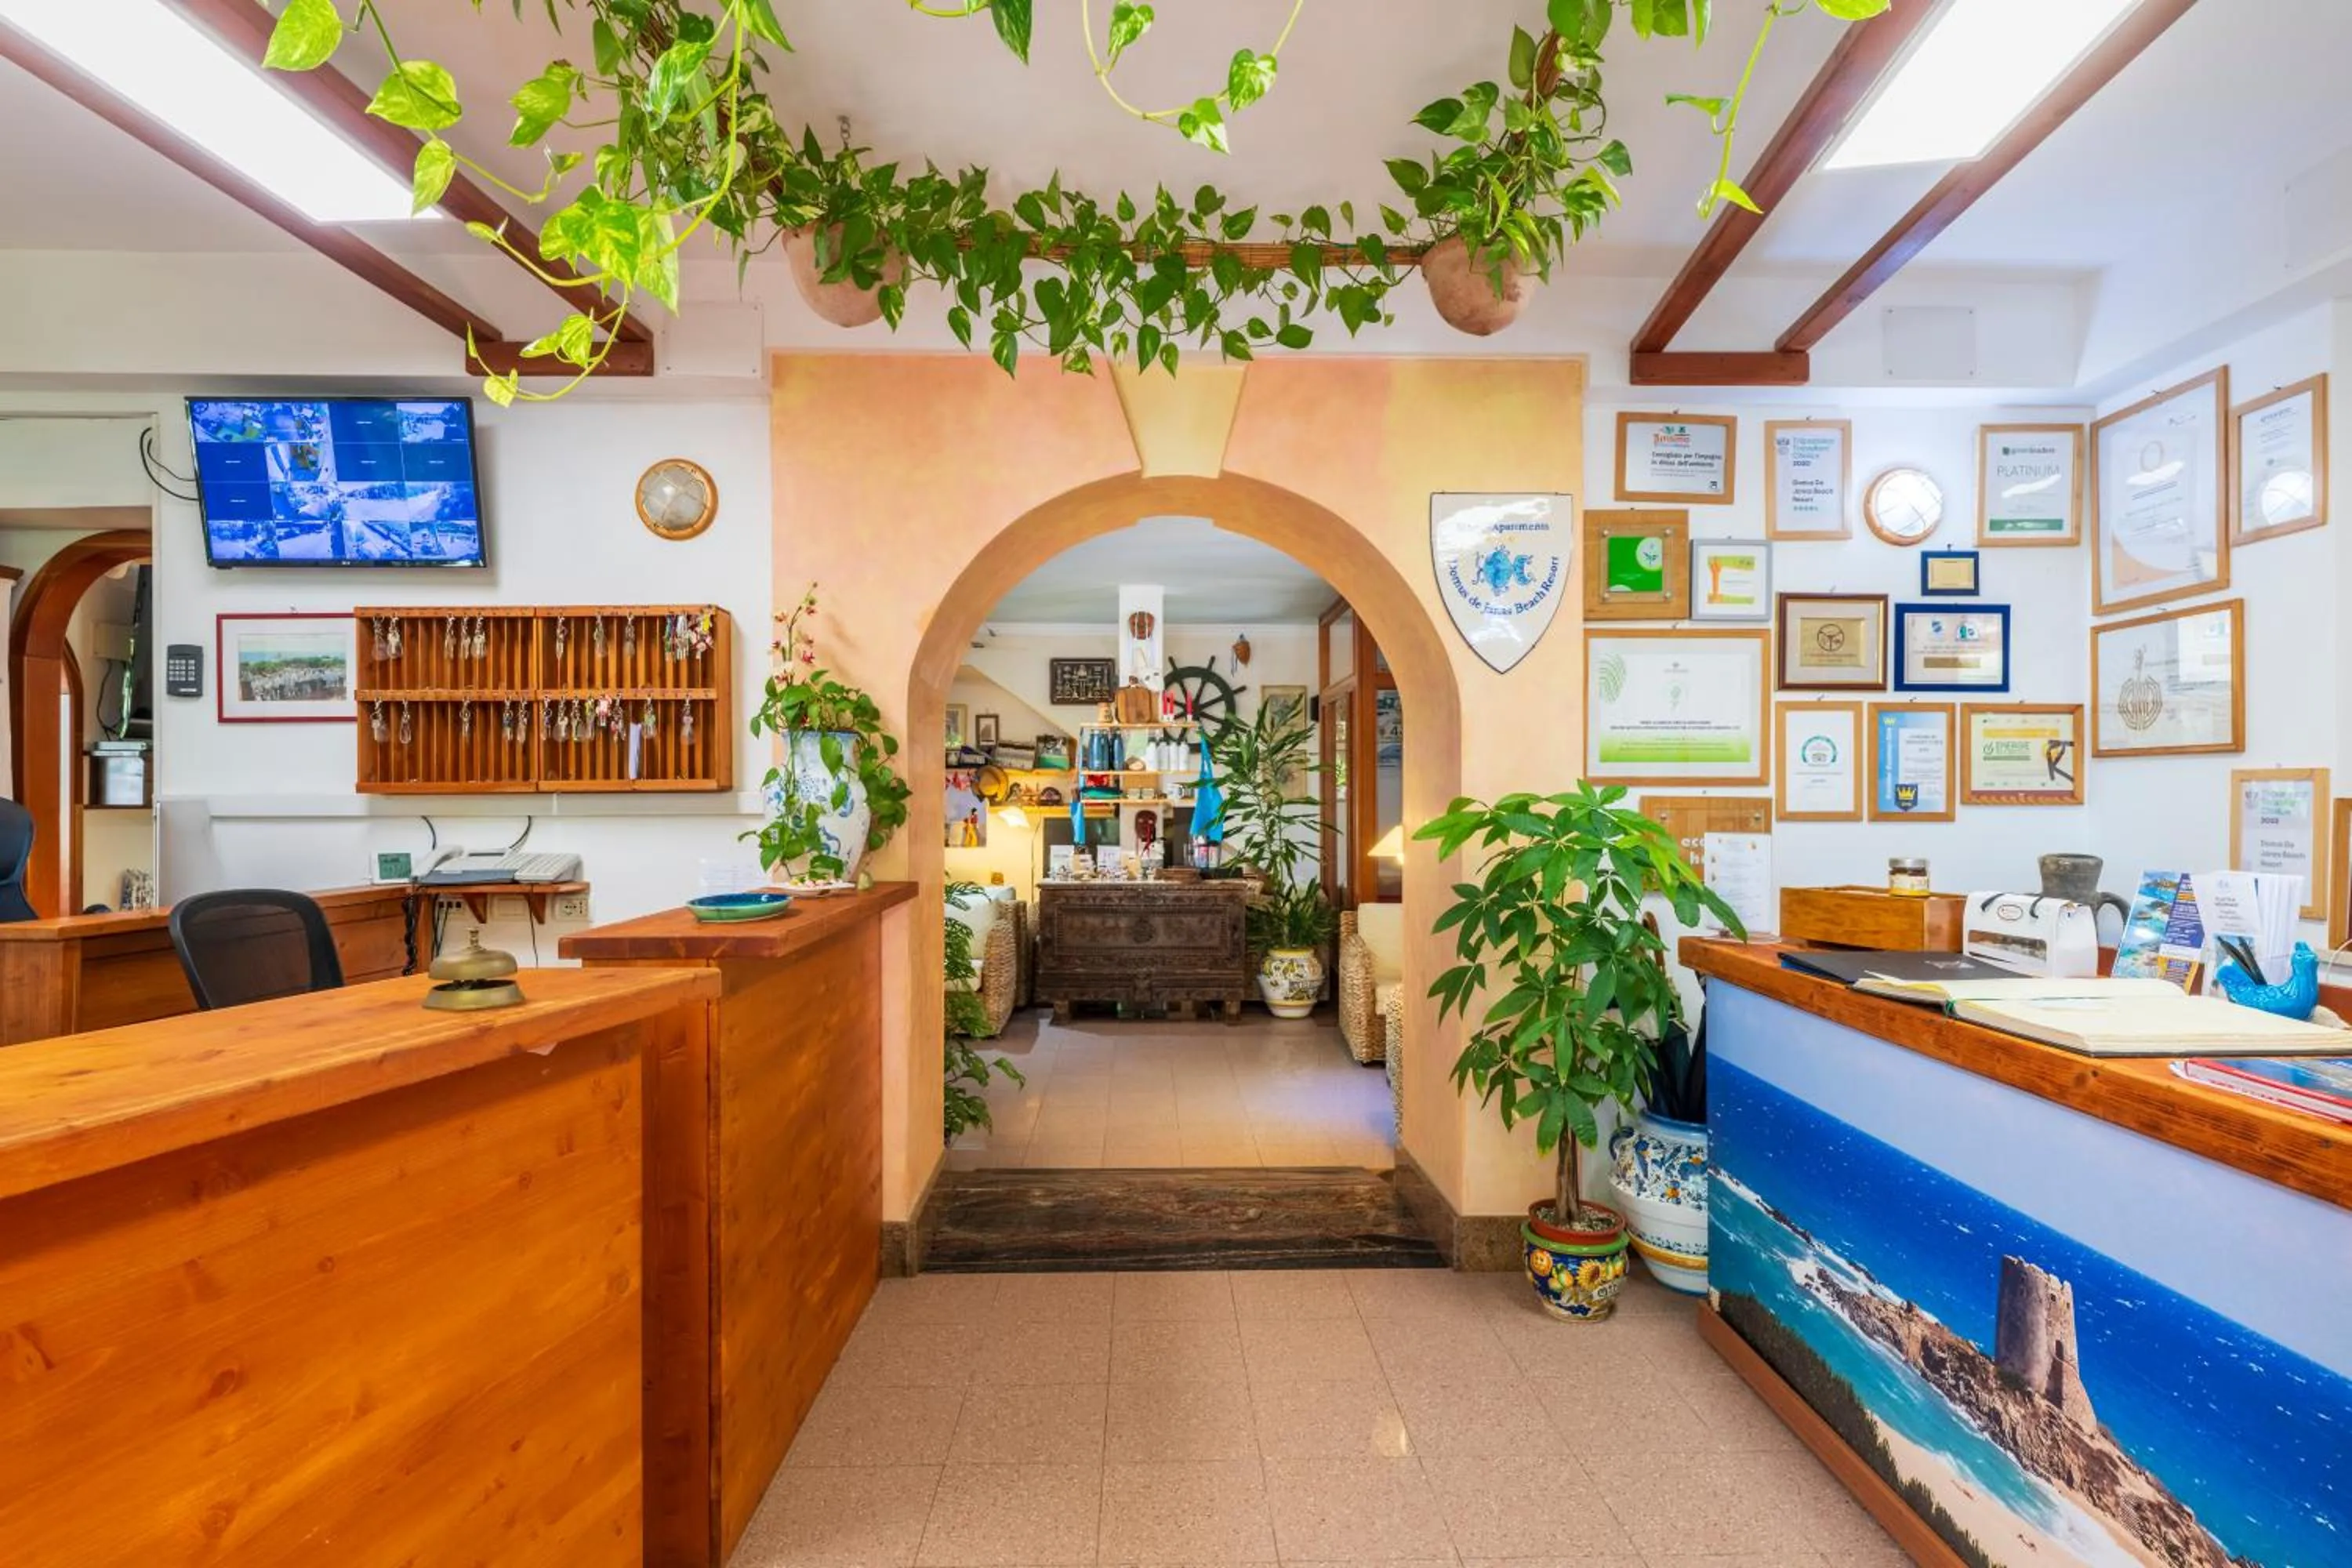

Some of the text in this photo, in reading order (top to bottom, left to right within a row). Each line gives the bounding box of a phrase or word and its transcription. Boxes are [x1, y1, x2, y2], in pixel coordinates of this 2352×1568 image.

[1997, 465, 2060, 477] PLATINUM
[1492, 522, 1550, 533] Apartments
[1448, 557, 1468, 599] Domus
[1468, 595, 1482, 609] de
[1515, 590, 1547, 615] Beach
[1540, 555, 1559, 593] Resort
